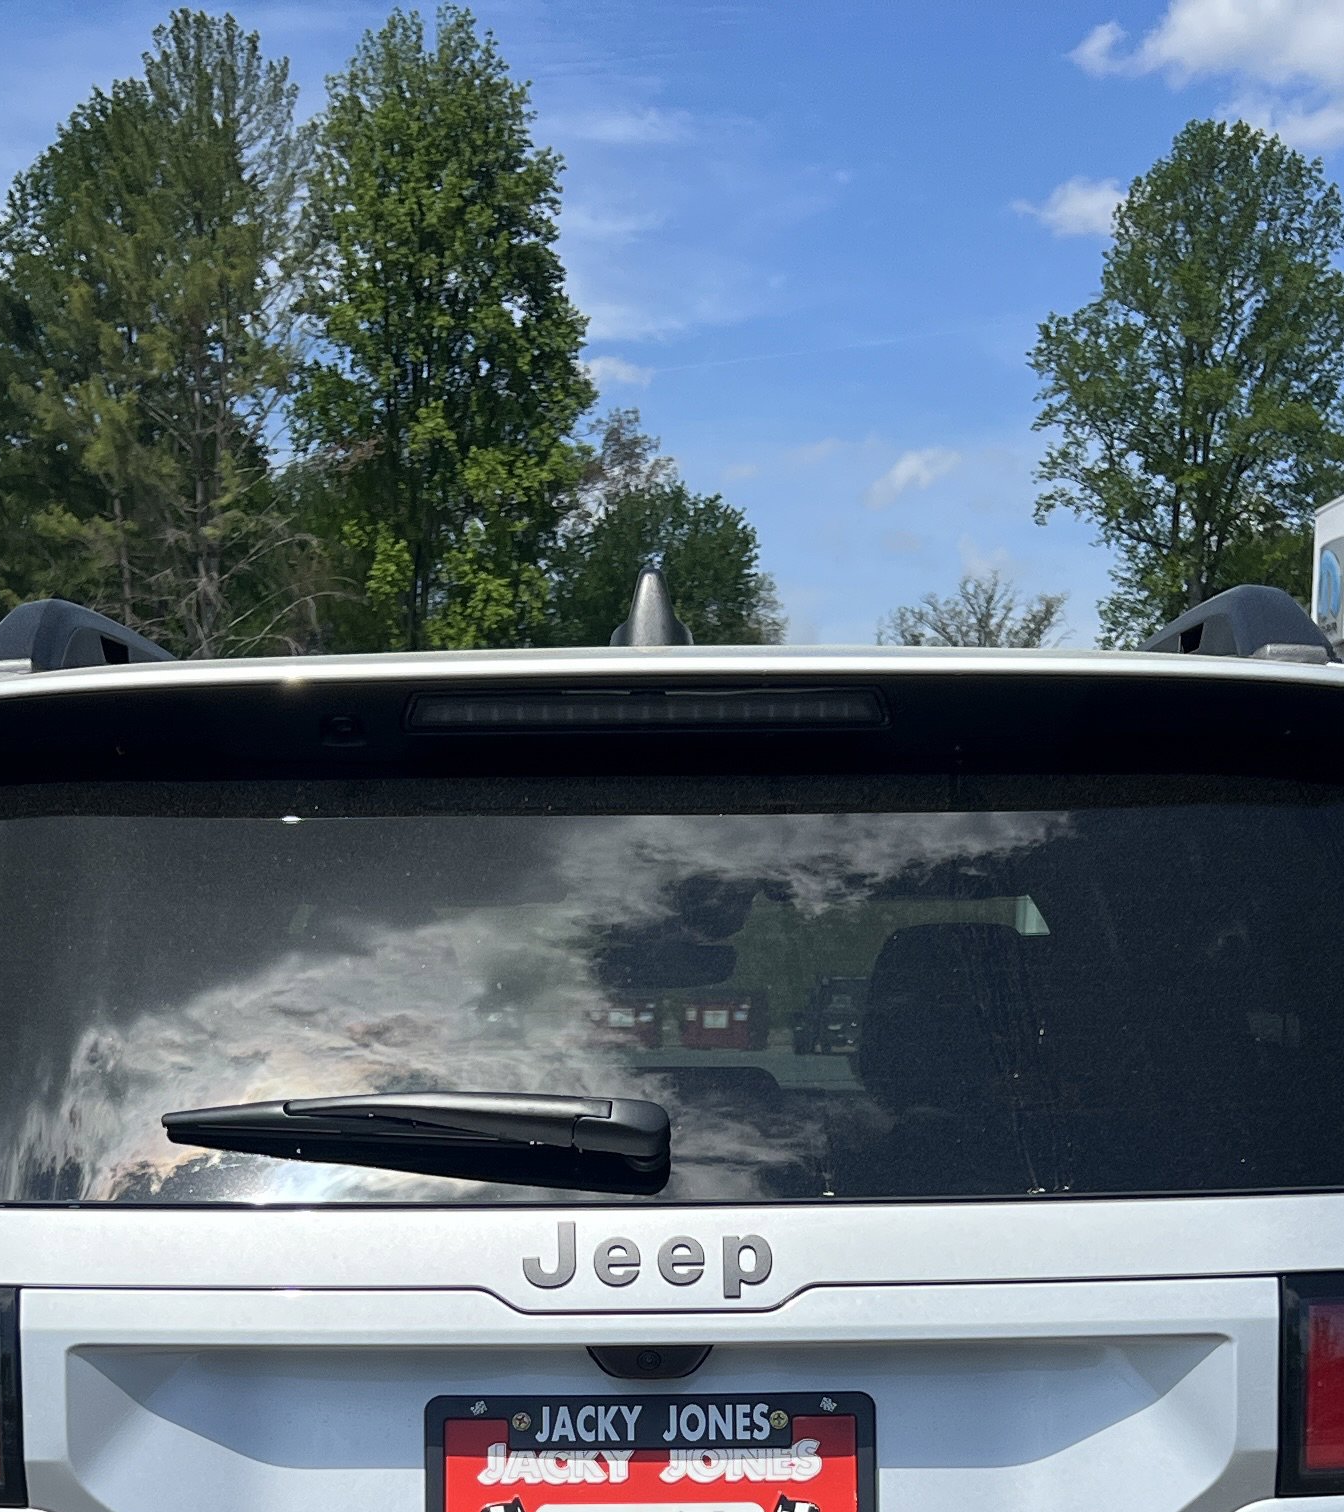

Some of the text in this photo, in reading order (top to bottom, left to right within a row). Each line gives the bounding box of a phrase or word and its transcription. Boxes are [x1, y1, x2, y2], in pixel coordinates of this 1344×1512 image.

[522, 1220, 774, 1300] Jeep
[535, 1402, 770, 1444] JACKY JONES
[477, 1437, 823, 1485] JACKY JONES
